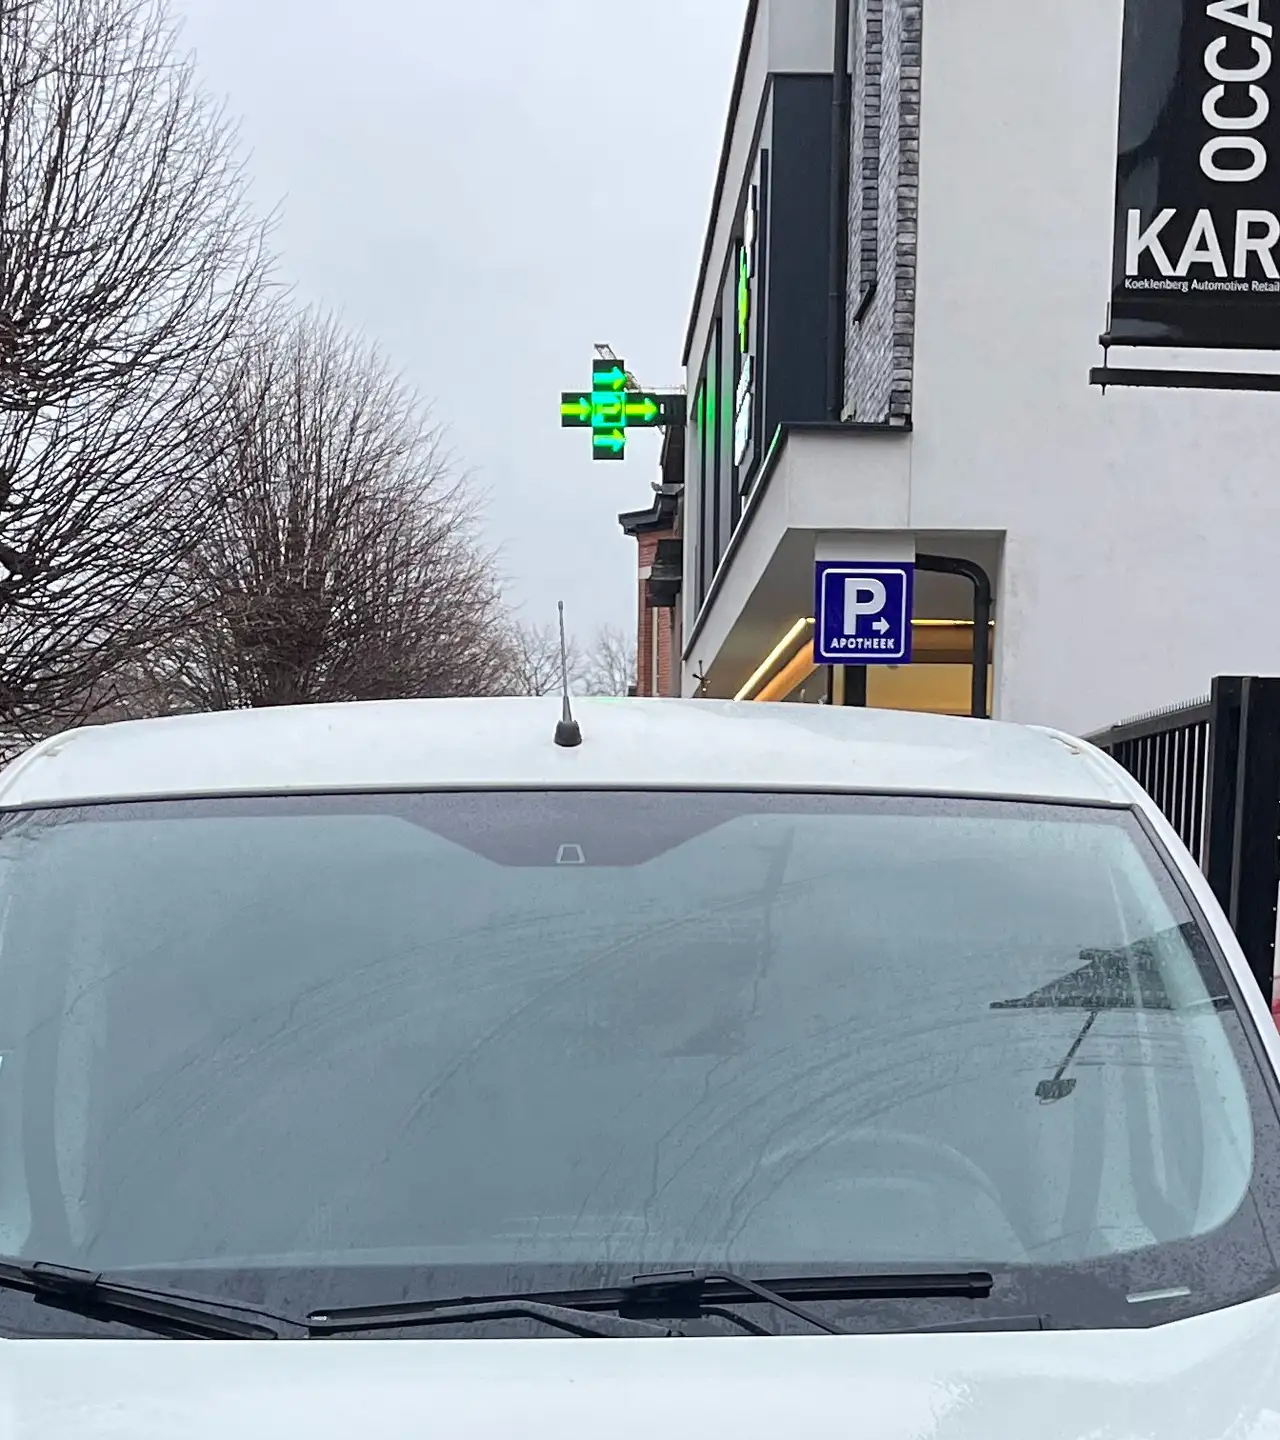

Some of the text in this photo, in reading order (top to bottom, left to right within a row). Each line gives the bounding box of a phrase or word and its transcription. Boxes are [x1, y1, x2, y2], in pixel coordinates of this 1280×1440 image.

[1124, 278, 1189, 293] Koeklenberg
[1191, 279, 1249, 292] Automotive
[1251, 280, 1280, 292] Retail
[843, 577, 887, 636] P
[830, 637, 895, 650] APOTHEEK
